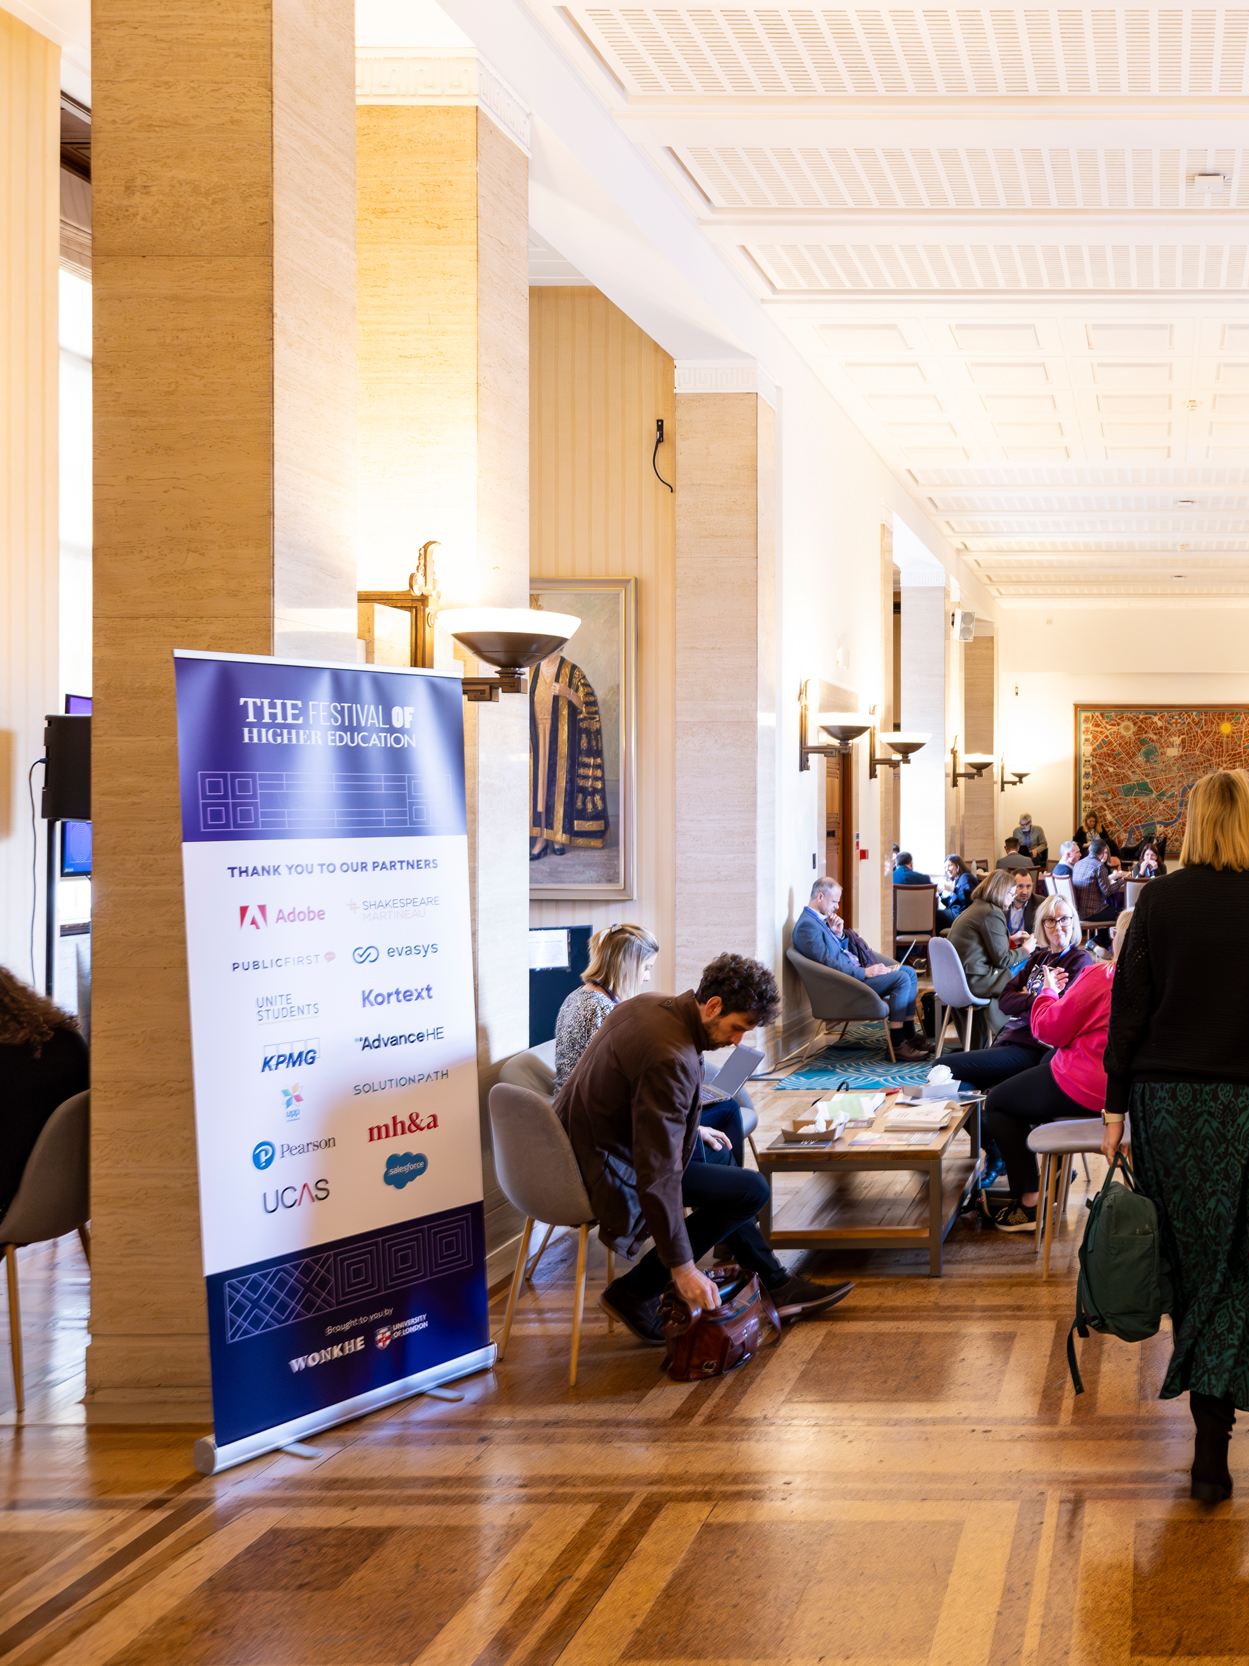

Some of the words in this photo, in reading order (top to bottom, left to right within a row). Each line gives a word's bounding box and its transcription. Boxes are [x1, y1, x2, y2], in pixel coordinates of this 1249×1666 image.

[239, 697, 304, 723] THE
[308, 701, 390, 728] FESTIVAL
[391, 706, 415, 729] OF
[242, 727, 323, 745] HIGHER
[327, 731, 416, 748] EDUCATION
[227, 864, 282, 878] THANK
[285, 863, 314, 876] YOU
[317, 862, 337, 874] TO
[339, 861, 369, 873] OUR
[372, 858, 439, 872] PARTNERS
[362, 896, 441, 910] SHAKESPEARE
[275, 906, 326, 924] Adobe
[362, 908, 426, 921] MARTINEAU
[386, 943, 439, 958] evasys
[232, 954, 321, 972] PUBLICFIRST
[256, 993, 293, 1008] UNITE
[361, 983, 434, 1008] Kortext
[256, 1002, 320, 1022] STUDENTS
[260, 1048, 318, 1073] KPMG
[353, 1069, 450, 1096] SOLUTIONPATH
[367, 1111, 440, 1143] mh&a
[279, 1136, 336, 1160] Pearson
[387, 1160, 425, 1176] salesforce
[263, 1178, 331, 1214] UCAS
[324, 1318, 359, 1337] Brought
[359, 1315, 369, 1326] to
[369, 1311, 384, 1322] you
[383, 1307, 394, 1317] by
[391, 1313, 427, 1331] UNIVERSITY
[392, 1329, 401, 1340] OF
[401, 1321, 429, 1336] LONDON
[288, 1335, 366, 1374] WONKHE
